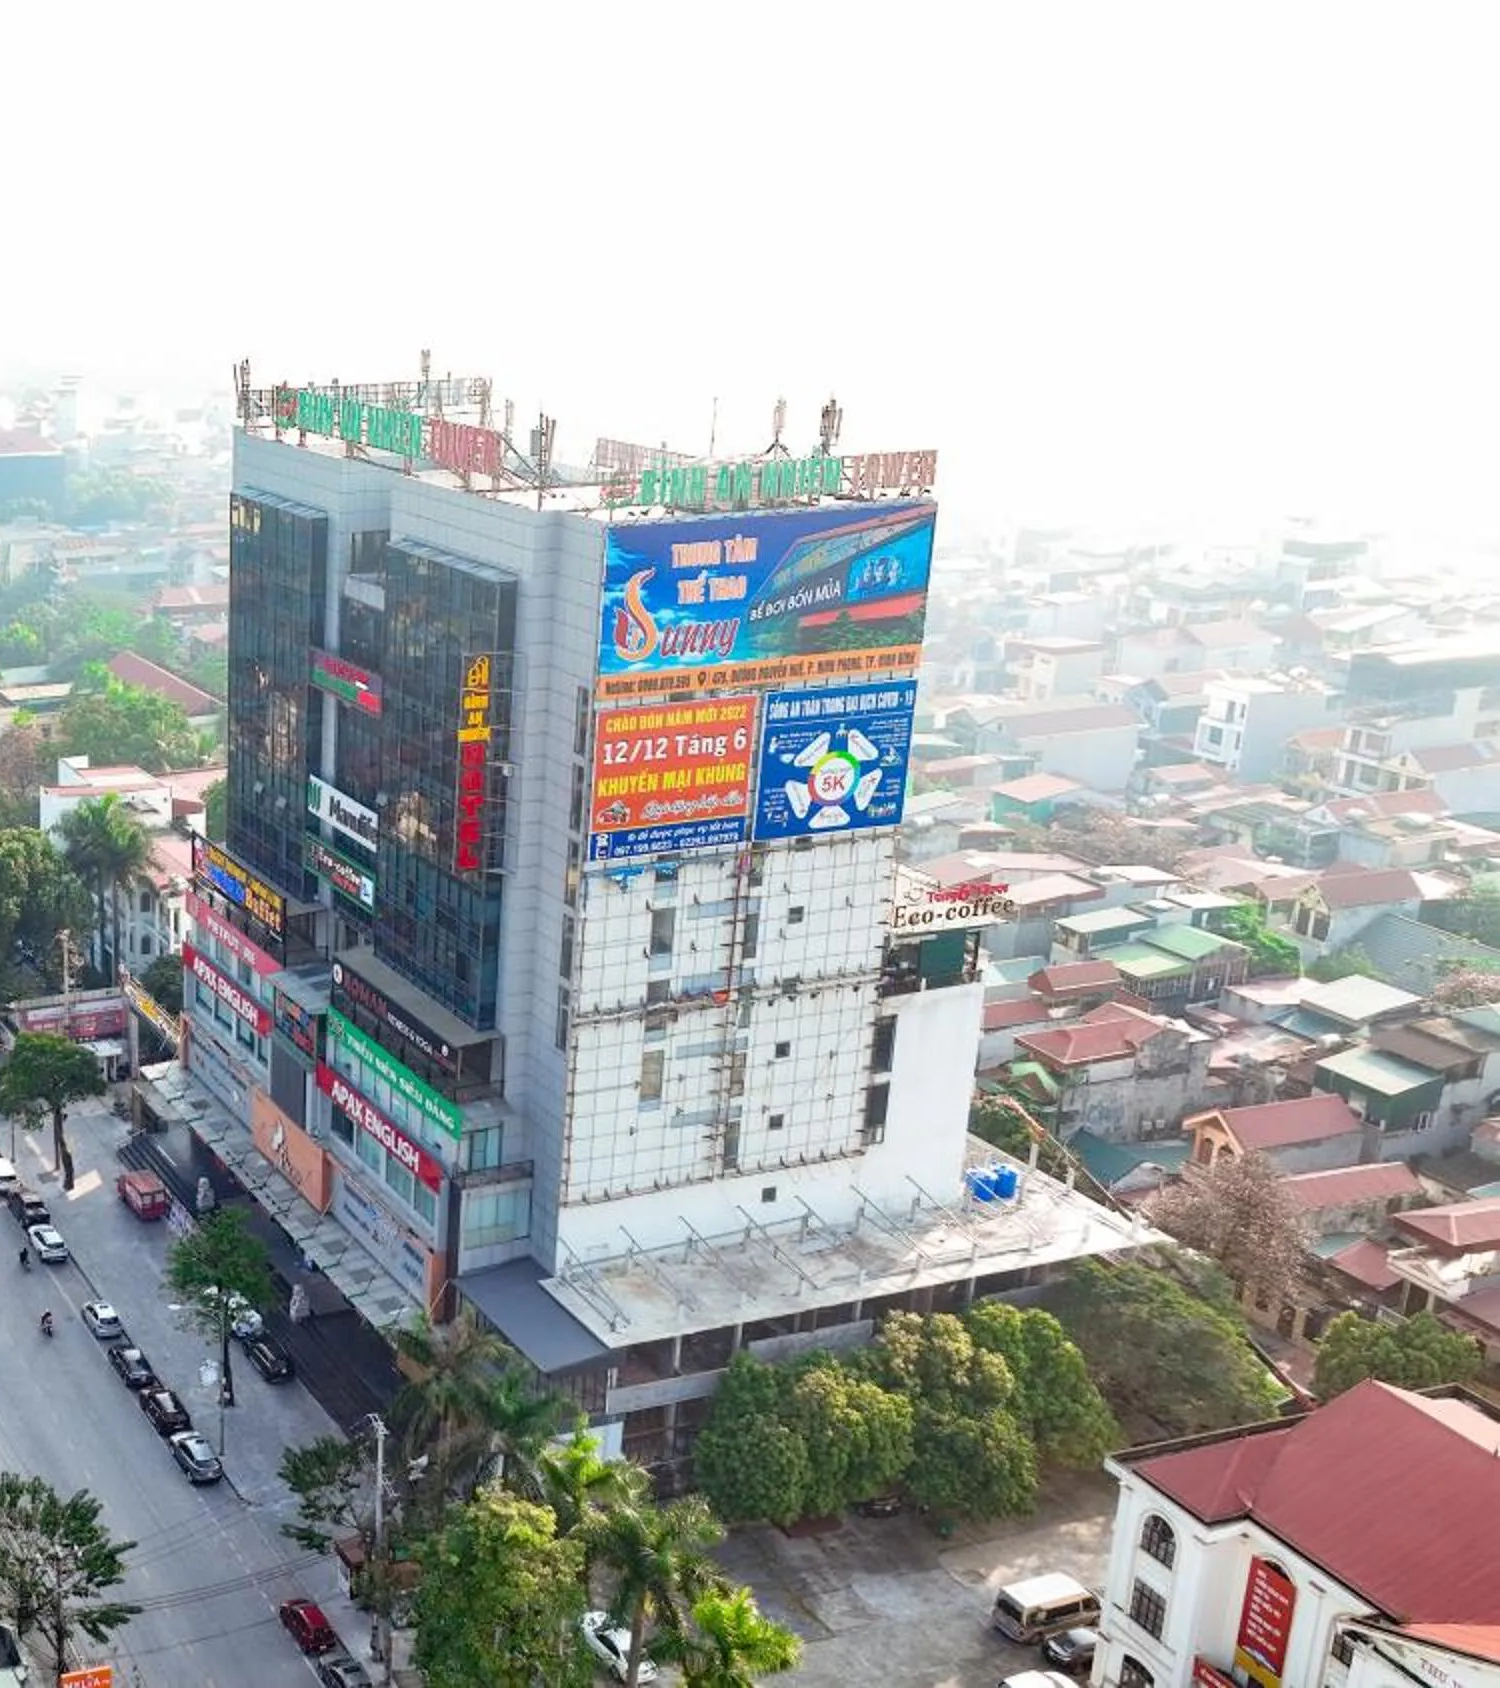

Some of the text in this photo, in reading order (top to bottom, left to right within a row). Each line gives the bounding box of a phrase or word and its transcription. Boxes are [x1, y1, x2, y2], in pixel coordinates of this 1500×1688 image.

[851, 449, 938, 491] TOWER
[671, 534, 758, 568] TRUNG TÂM
[707, 576, 747, 602] THAO
[615, 567, 740, 662] Sunny
[718, 704, 747, 721] 2022
[790, 701, 800, 717] AN
[878, 691, 899, 711] COVID
[603, 736, 669, 765] 12/12
[733, 727, 748, 750] 6
[663, 770, 692, 793] MẠI
[821, 775, 845, 793] 5K
[458, 743, 486, 870] HOTEL
[893, 898, 1016, 929] Eco-coffee
[193, 956, 217, 993] APAX
[217, 978, 258, 1027] ENGLISH
[331, 1080, 363, 1122] APAX
[364, 1107, 420, 1173] ENGLISH
